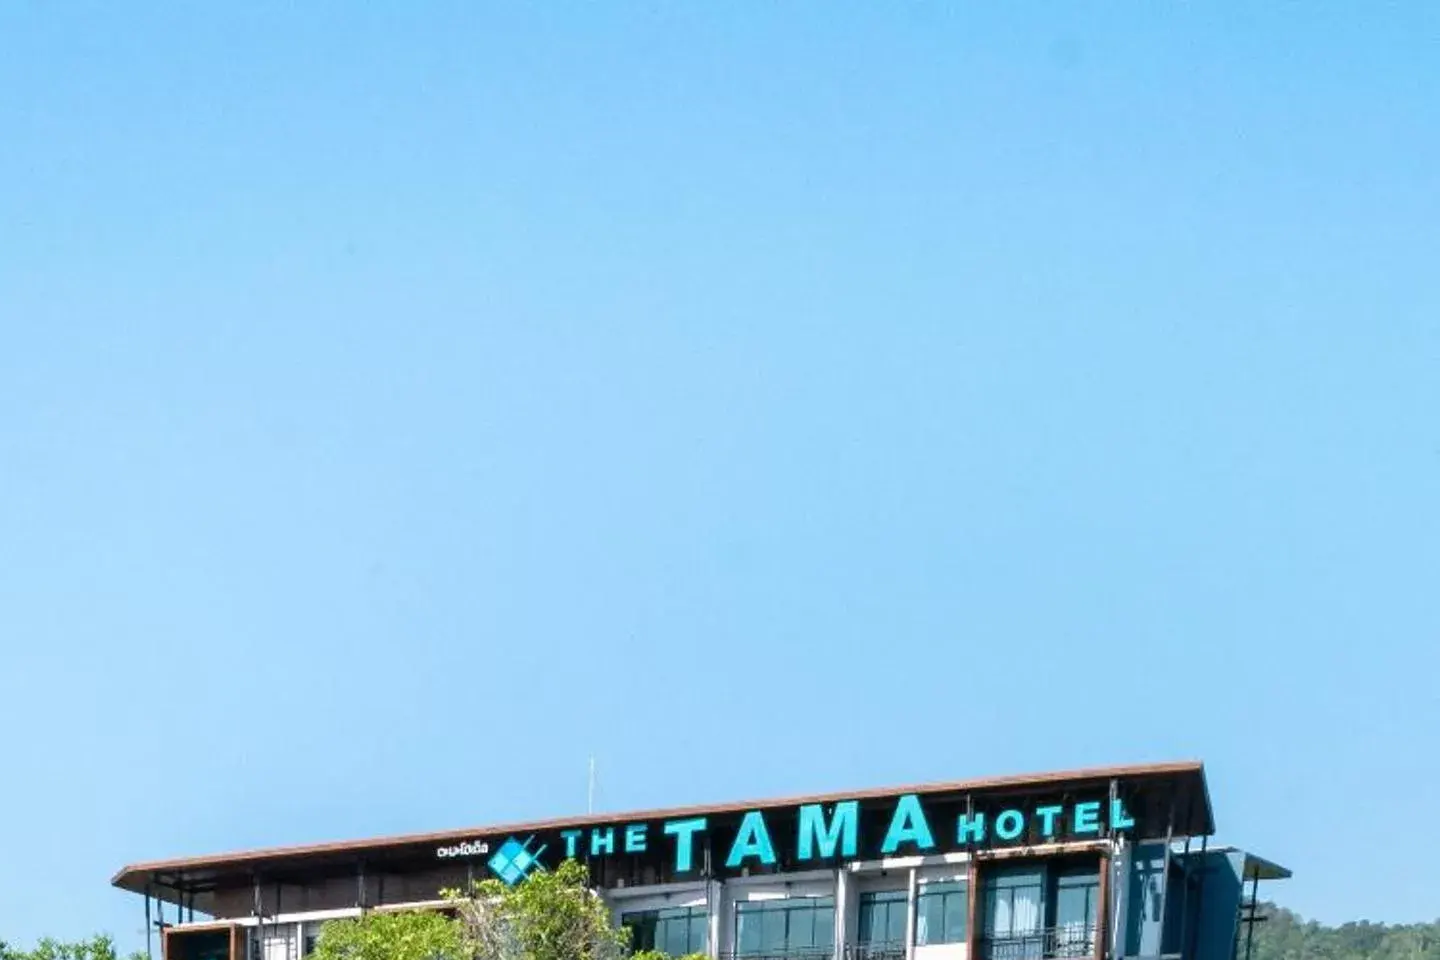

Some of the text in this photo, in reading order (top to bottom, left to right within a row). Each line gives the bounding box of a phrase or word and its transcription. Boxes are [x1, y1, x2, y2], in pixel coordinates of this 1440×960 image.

[560, 794, 1136, 872] THE TAMA HOTEL
